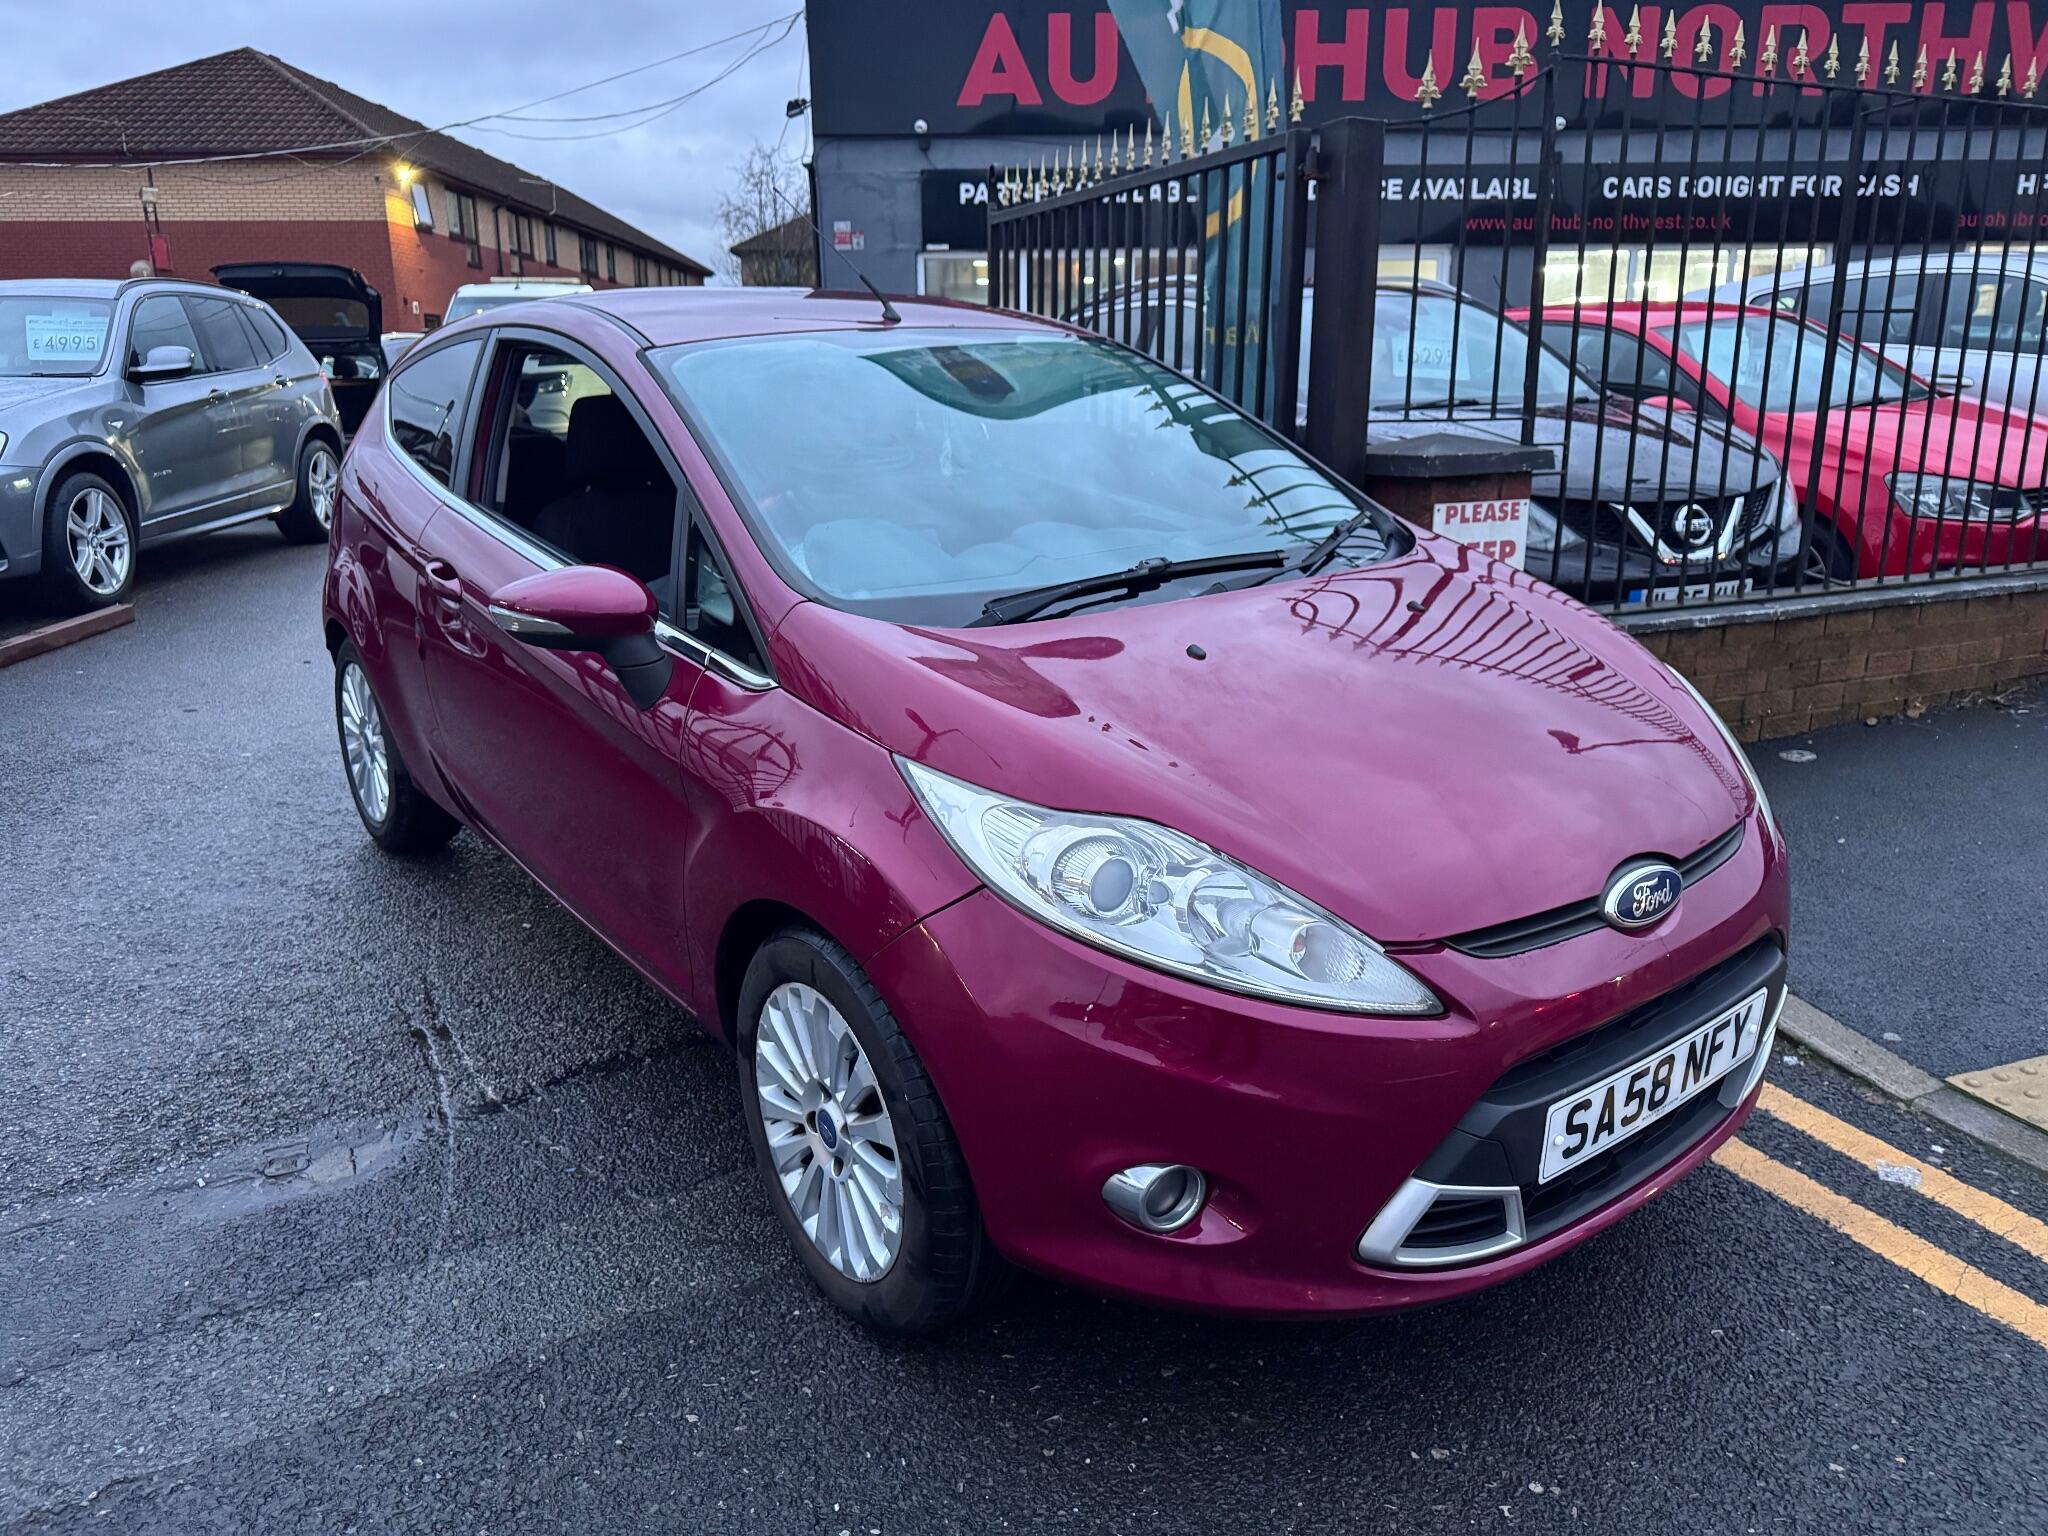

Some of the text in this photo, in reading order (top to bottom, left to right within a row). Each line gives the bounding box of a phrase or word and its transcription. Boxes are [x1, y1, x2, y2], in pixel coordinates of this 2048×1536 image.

[956, 7, 1539, 106] AUHUB
[1602, 176, 1672, 199] CARS
[1789, 174, 1843, 197] FOR
[1445, 502, 1520, 524] PLEASE
[1632, 877, 1673, 917] Ford
[1562, 1004, 1753, 1160] SA58 NFY
